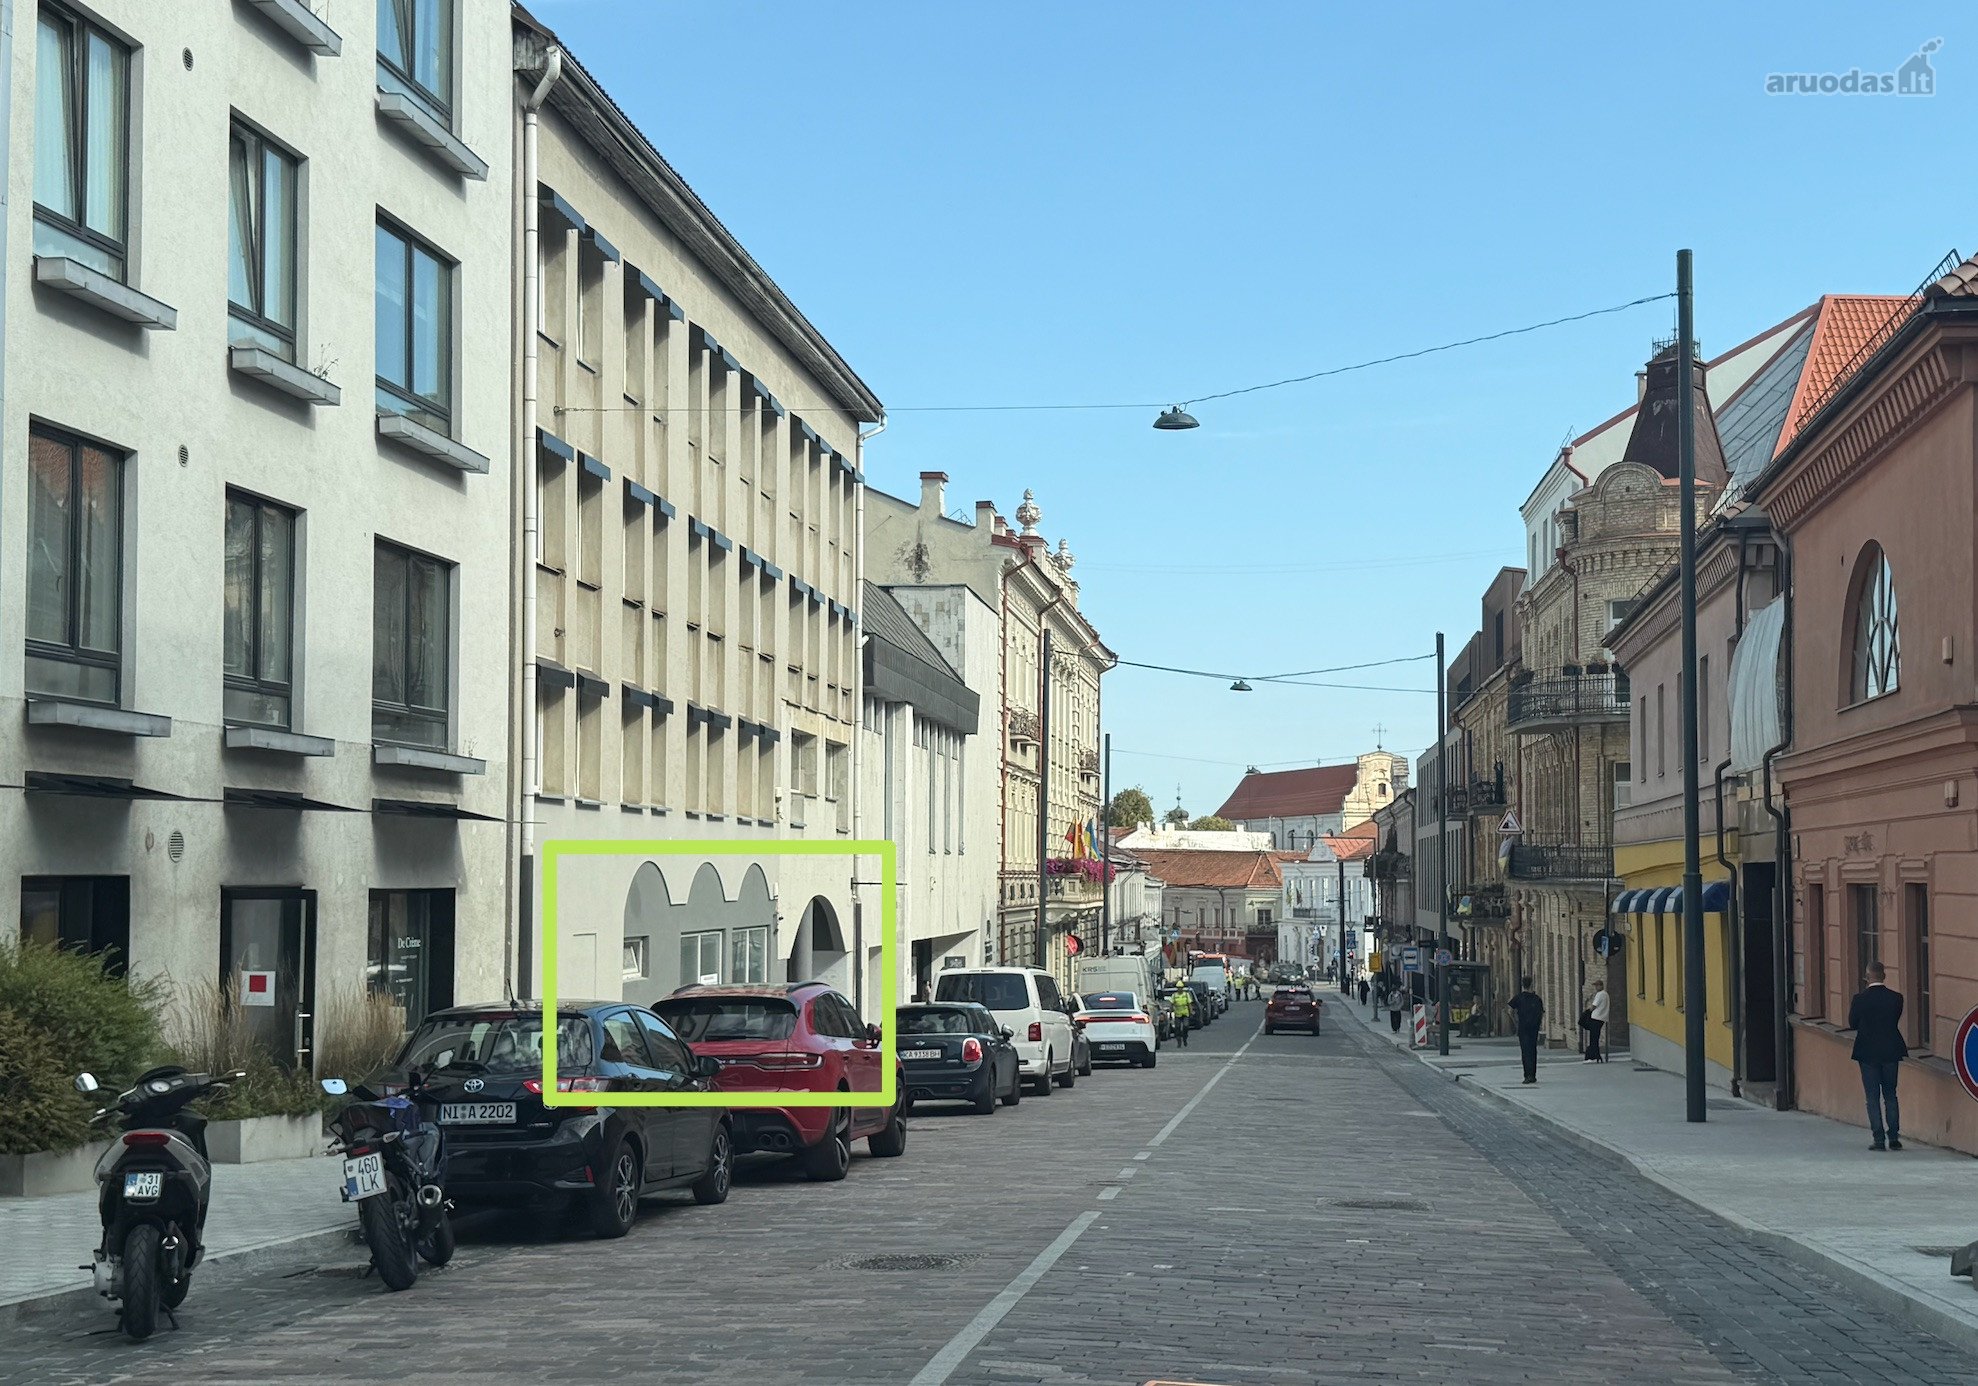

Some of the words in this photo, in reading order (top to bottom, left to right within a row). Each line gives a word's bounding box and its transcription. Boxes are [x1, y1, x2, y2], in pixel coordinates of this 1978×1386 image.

[443, 1106, 459, 1119] NI
[468, 1106, 476, 1119] A
[480, 1105, 513, 1118] 2202
[359, 1156, 379, 1174] 460
[138, 1185, 158, 1195] AVG
[362, 1173, 379, 1192] LK
